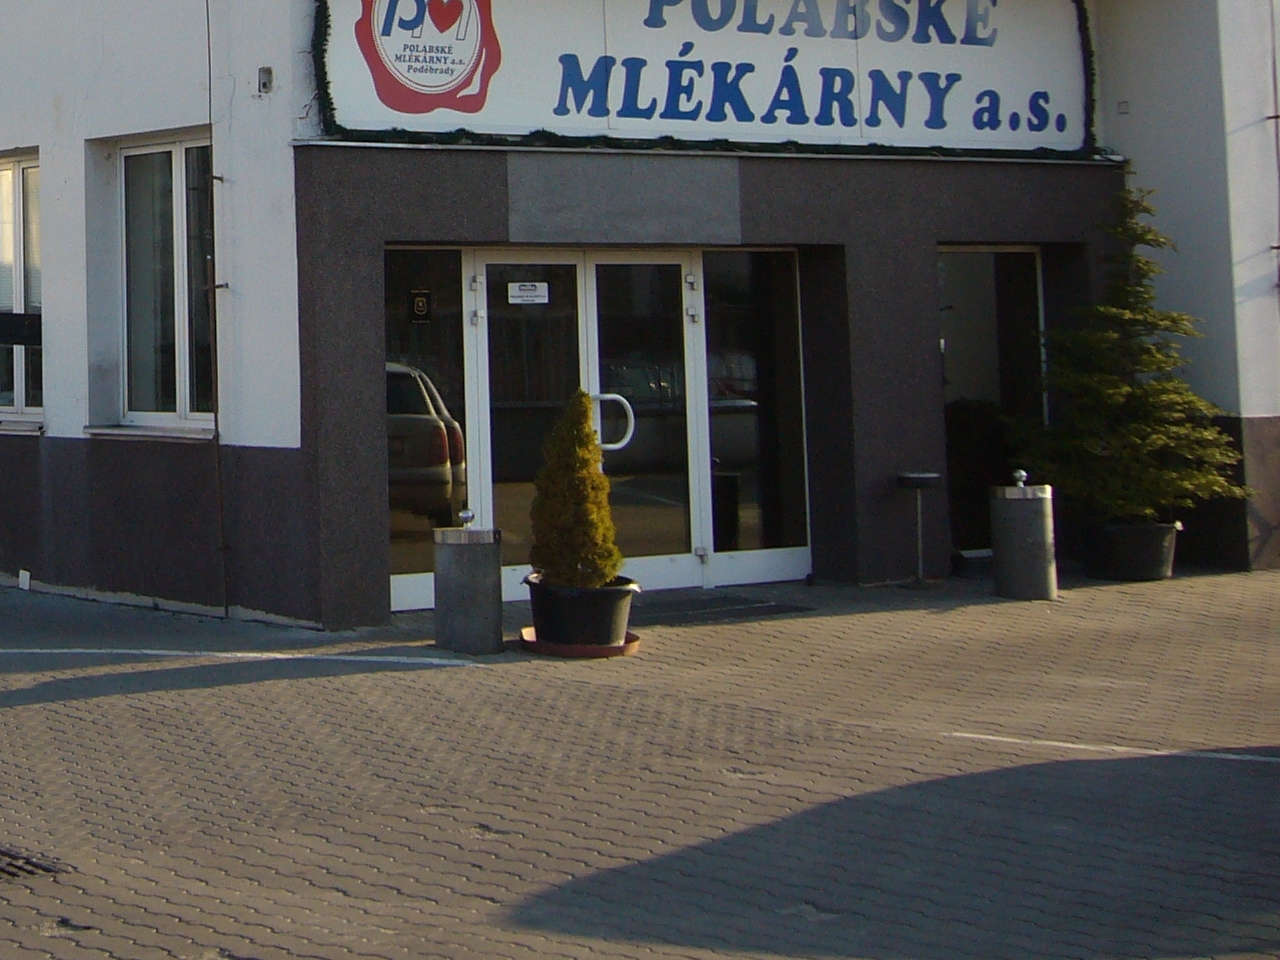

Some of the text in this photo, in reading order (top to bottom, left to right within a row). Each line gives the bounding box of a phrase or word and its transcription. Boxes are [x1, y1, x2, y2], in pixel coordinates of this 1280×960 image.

[403, 43, 454, 55] POLABSKÉ
[394, 51, 449, 65] MLÉKÁRNY
[553, 41, 1068, 132] MLÉKÁRNY a.s.
